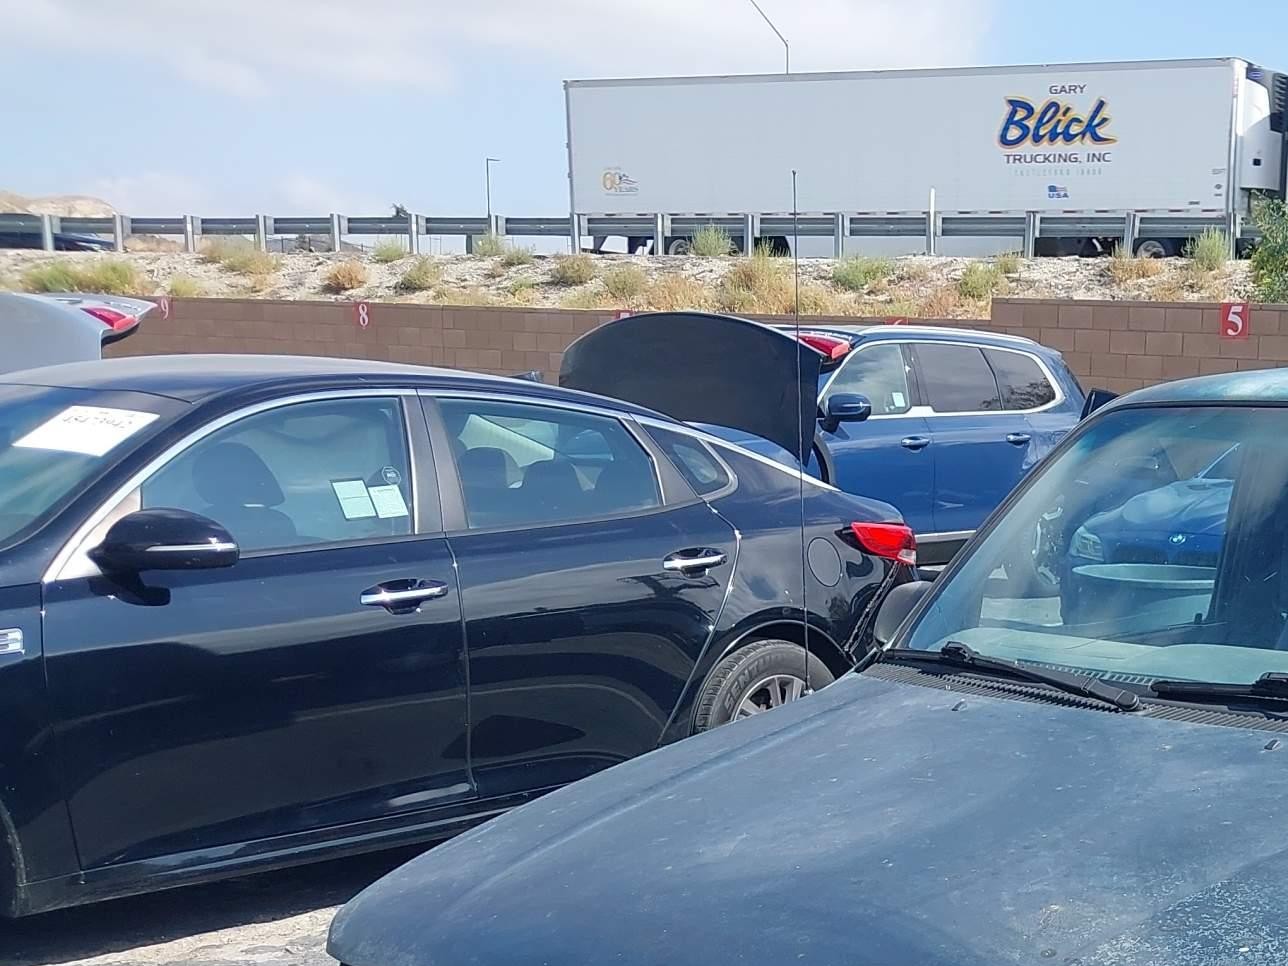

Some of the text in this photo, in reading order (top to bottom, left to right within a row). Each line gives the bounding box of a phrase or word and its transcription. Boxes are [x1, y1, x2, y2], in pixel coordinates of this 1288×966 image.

[1048, 84, 1087, 95] GARY
[999, 97, 1117, 147] Blick
[1004, 152, 1112, 165] TRUCKING, INC
[160, 298, 169, 320] 9
[358, 303, 369, 327] 8
[1226, 305, 1244, 336] 5
